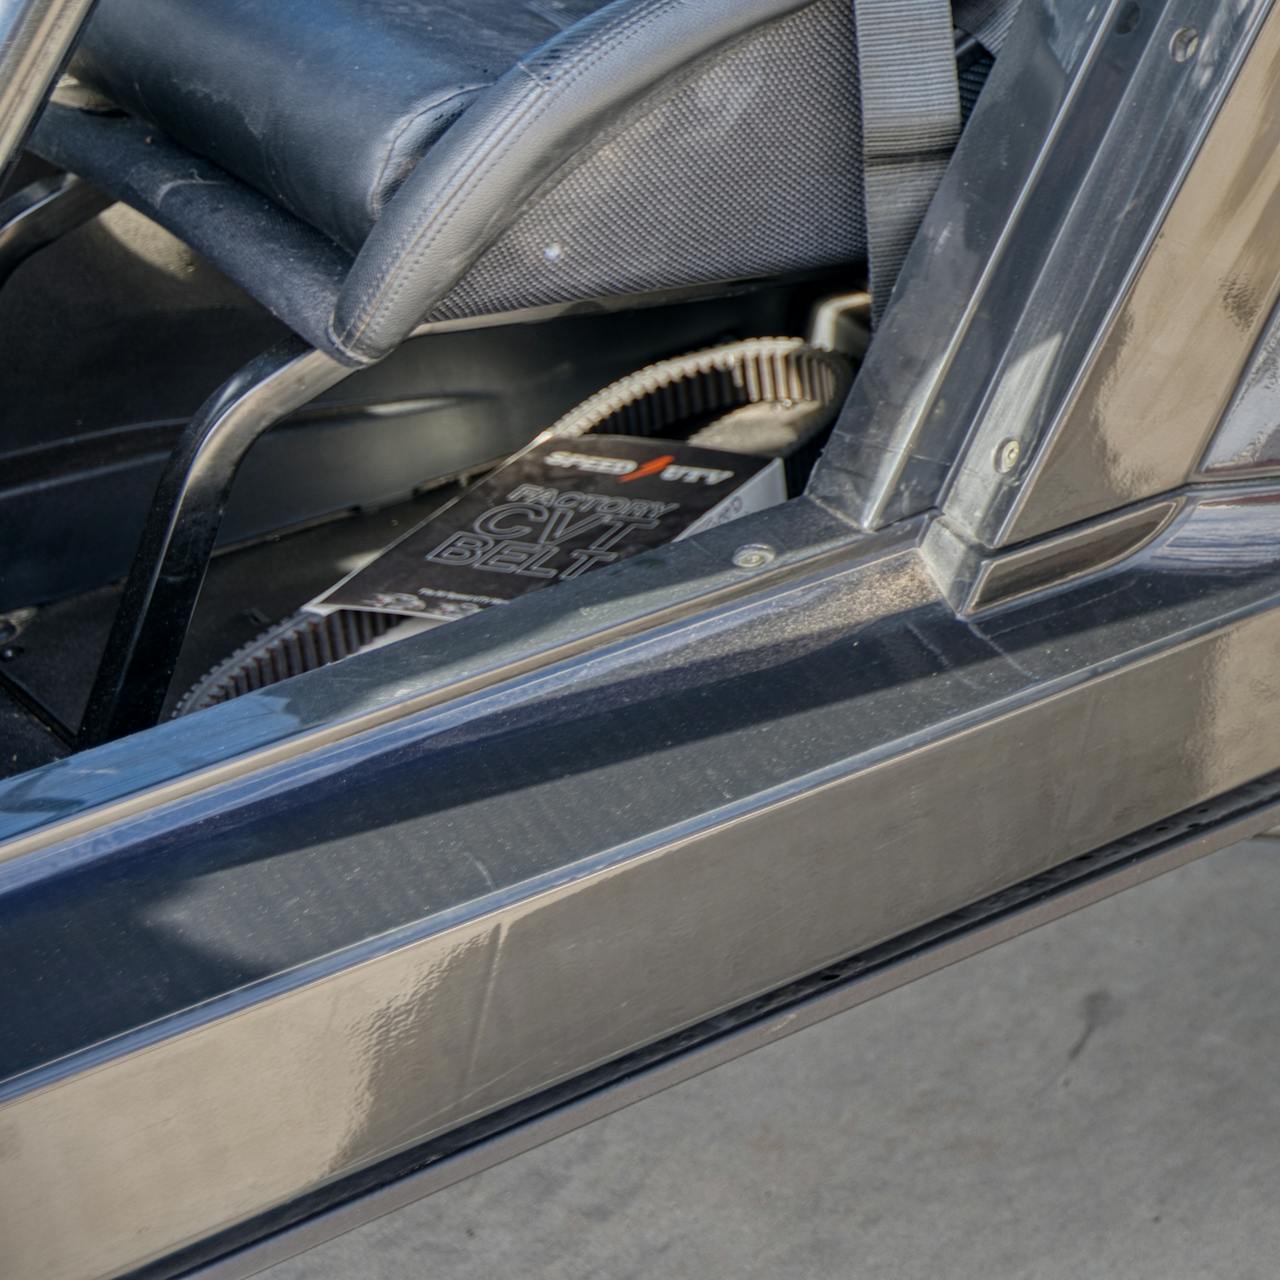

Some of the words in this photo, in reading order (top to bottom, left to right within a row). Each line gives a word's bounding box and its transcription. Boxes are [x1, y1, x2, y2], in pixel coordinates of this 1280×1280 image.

[544, 451, 638, 476] SPEED
[660, 464, 735, 485] UTV
[506, 483, 680, 519] FACTORY
[472, 501, 661, 551] CVT
[425, 530, 619, 581] BELT
